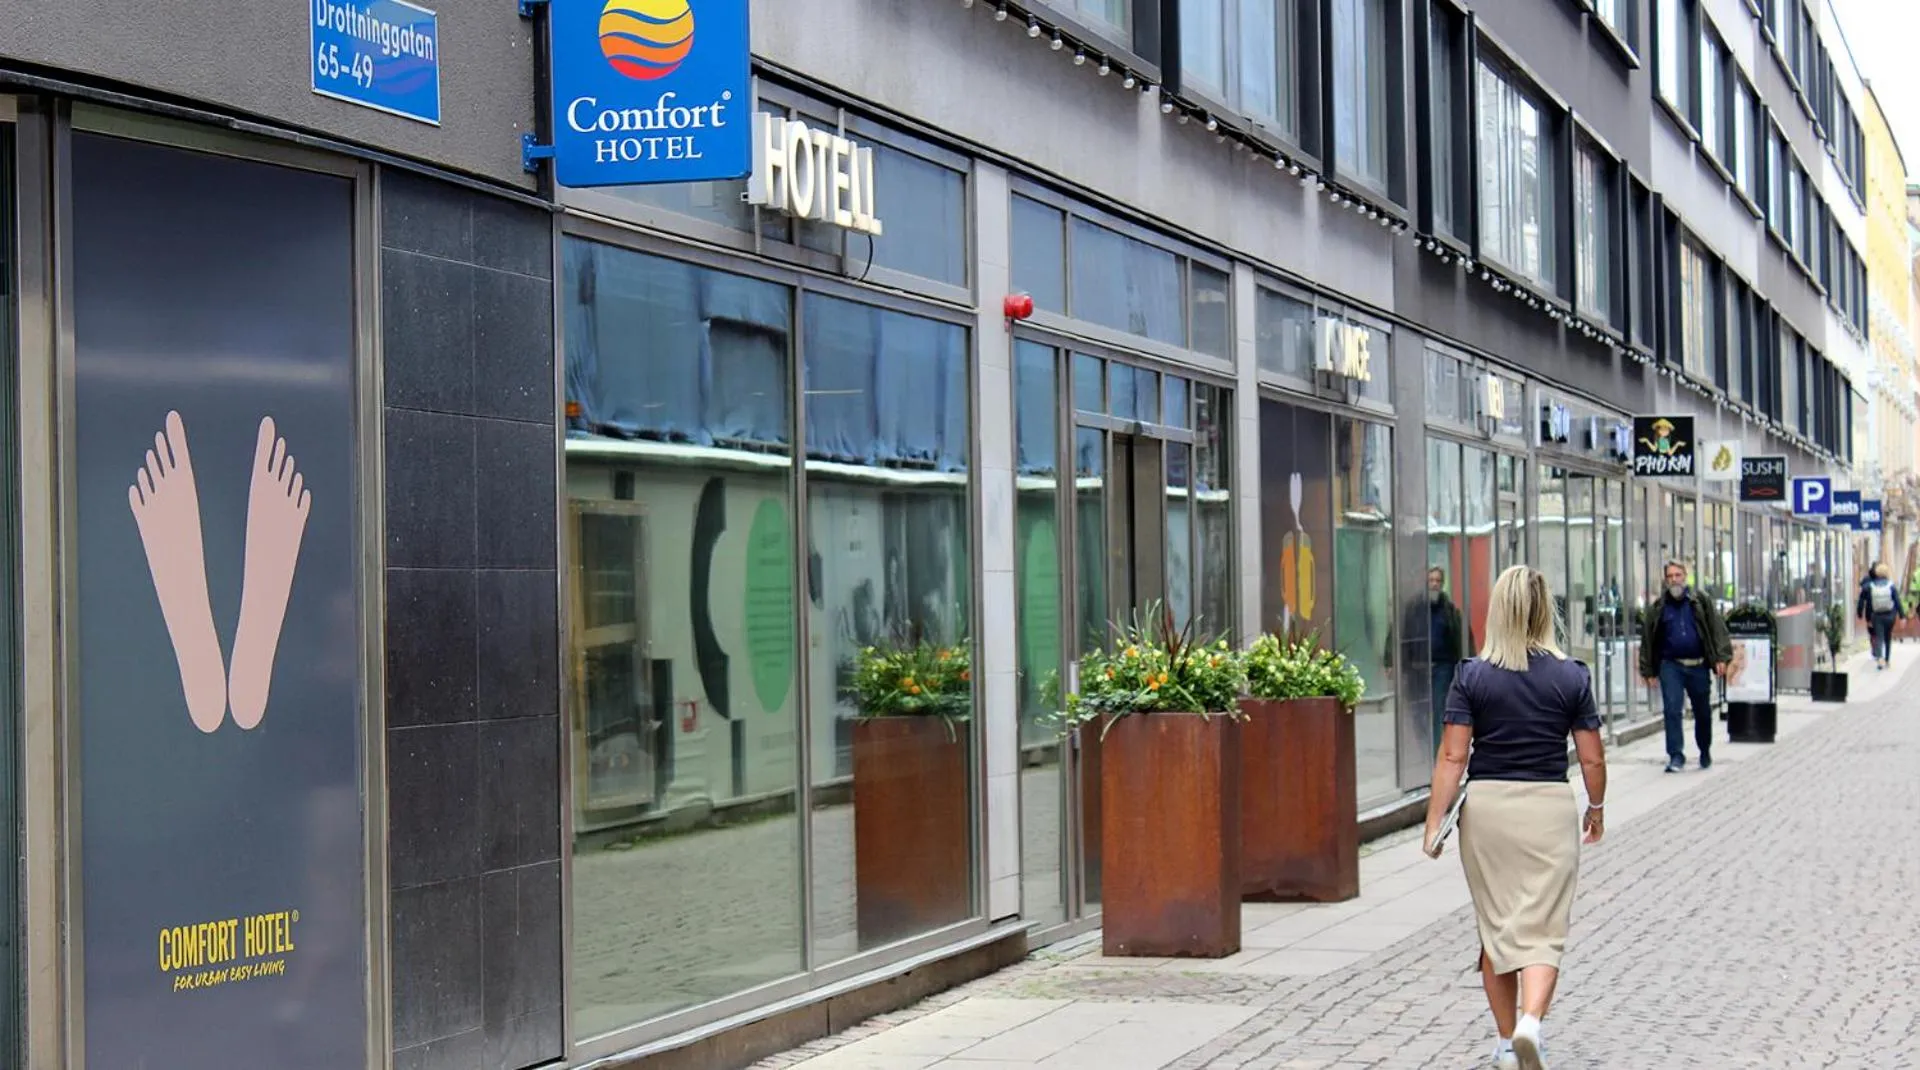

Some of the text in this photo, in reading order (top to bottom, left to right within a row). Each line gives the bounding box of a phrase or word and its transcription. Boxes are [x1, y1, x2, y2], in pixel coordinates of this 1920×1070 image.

[316, 0, 434, 60] Drottninggatan
[595, 136, 703, 163] HOTEL
[751, 111, 882, 236] HOTELL
[1742, 461, 1784, 476] SUSHI
[1802, 481, 1825, 512] P
[159, 919, 238, 972] COMFORT
[173, 959, 286, 993] FOR URBAN EASY LIVING
